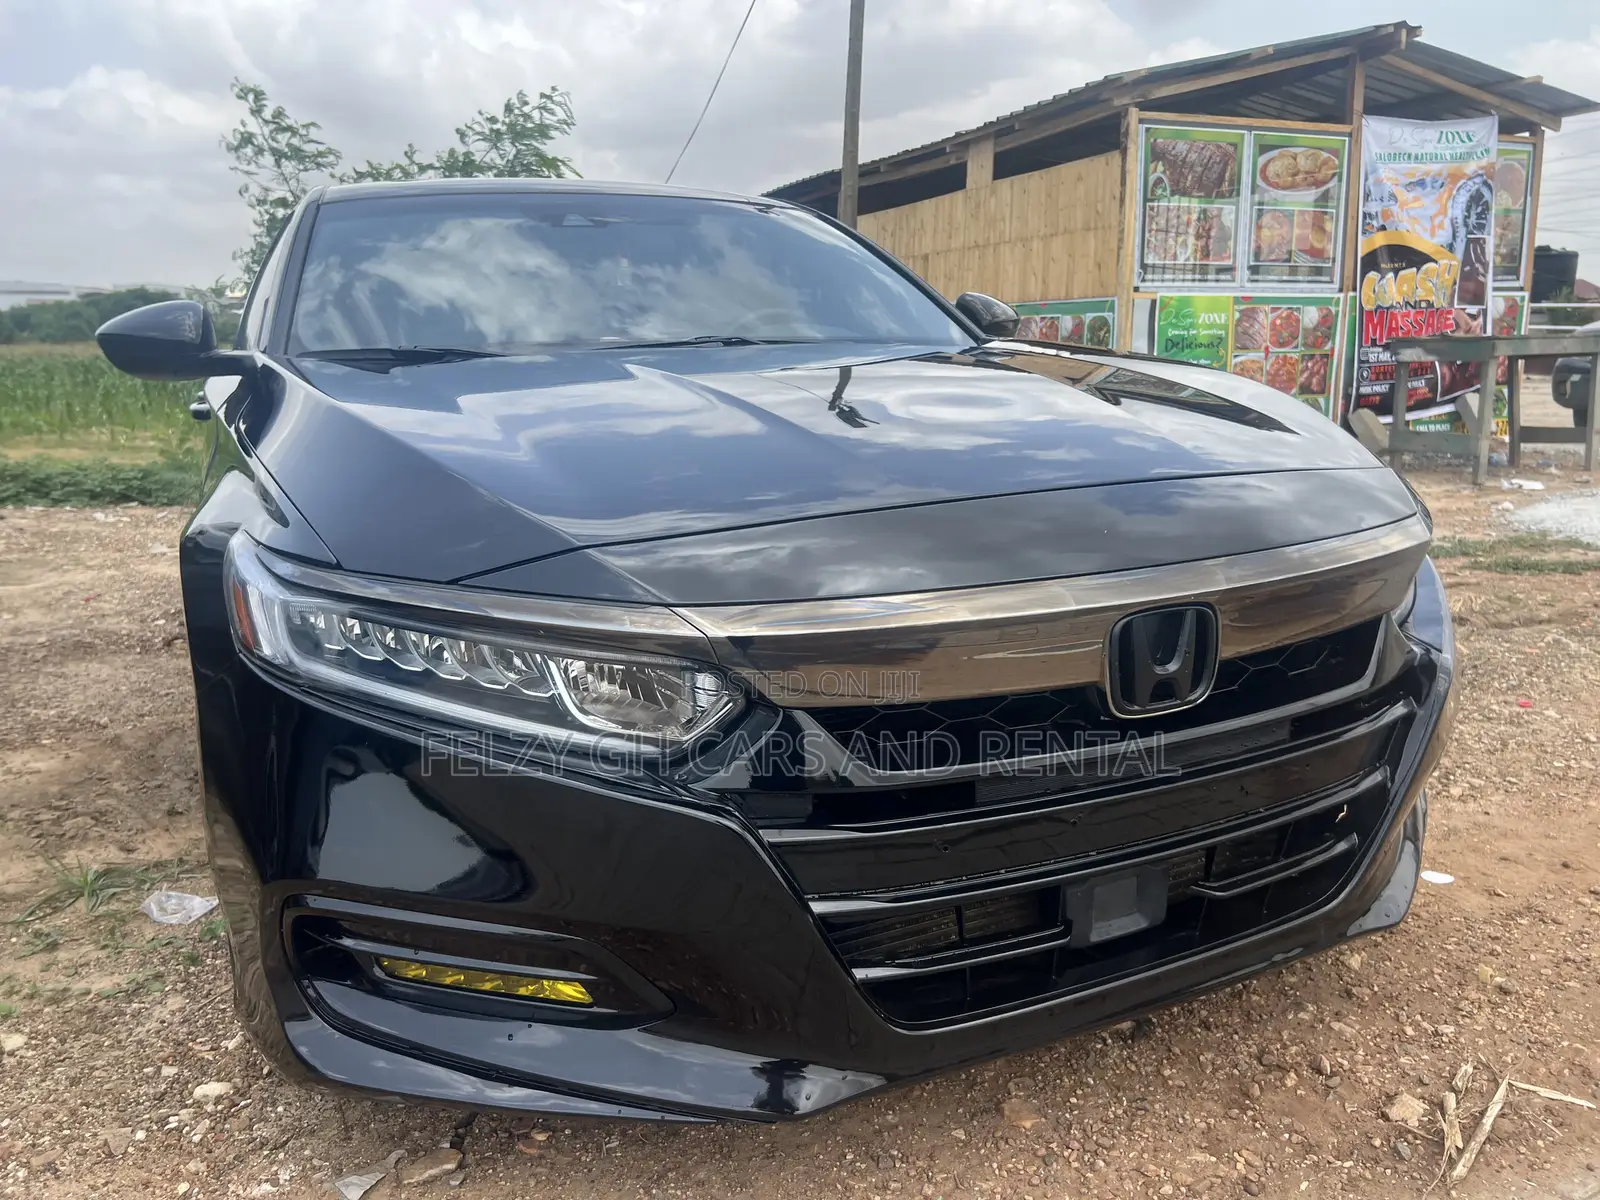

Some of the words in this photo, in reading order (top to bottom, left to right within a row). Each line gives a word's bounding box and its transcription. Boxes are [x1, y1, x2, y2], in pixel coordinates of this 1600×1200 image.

[1375, 152, 1411, 162] SALOBECK
[1414, 151, 1448, 162] NATURAL
[1361, 260, 1459, 311] WASH
[1363, 309, 1455, 346] MASSAGE
[1165, 337, 1223, 354] Delicious?
